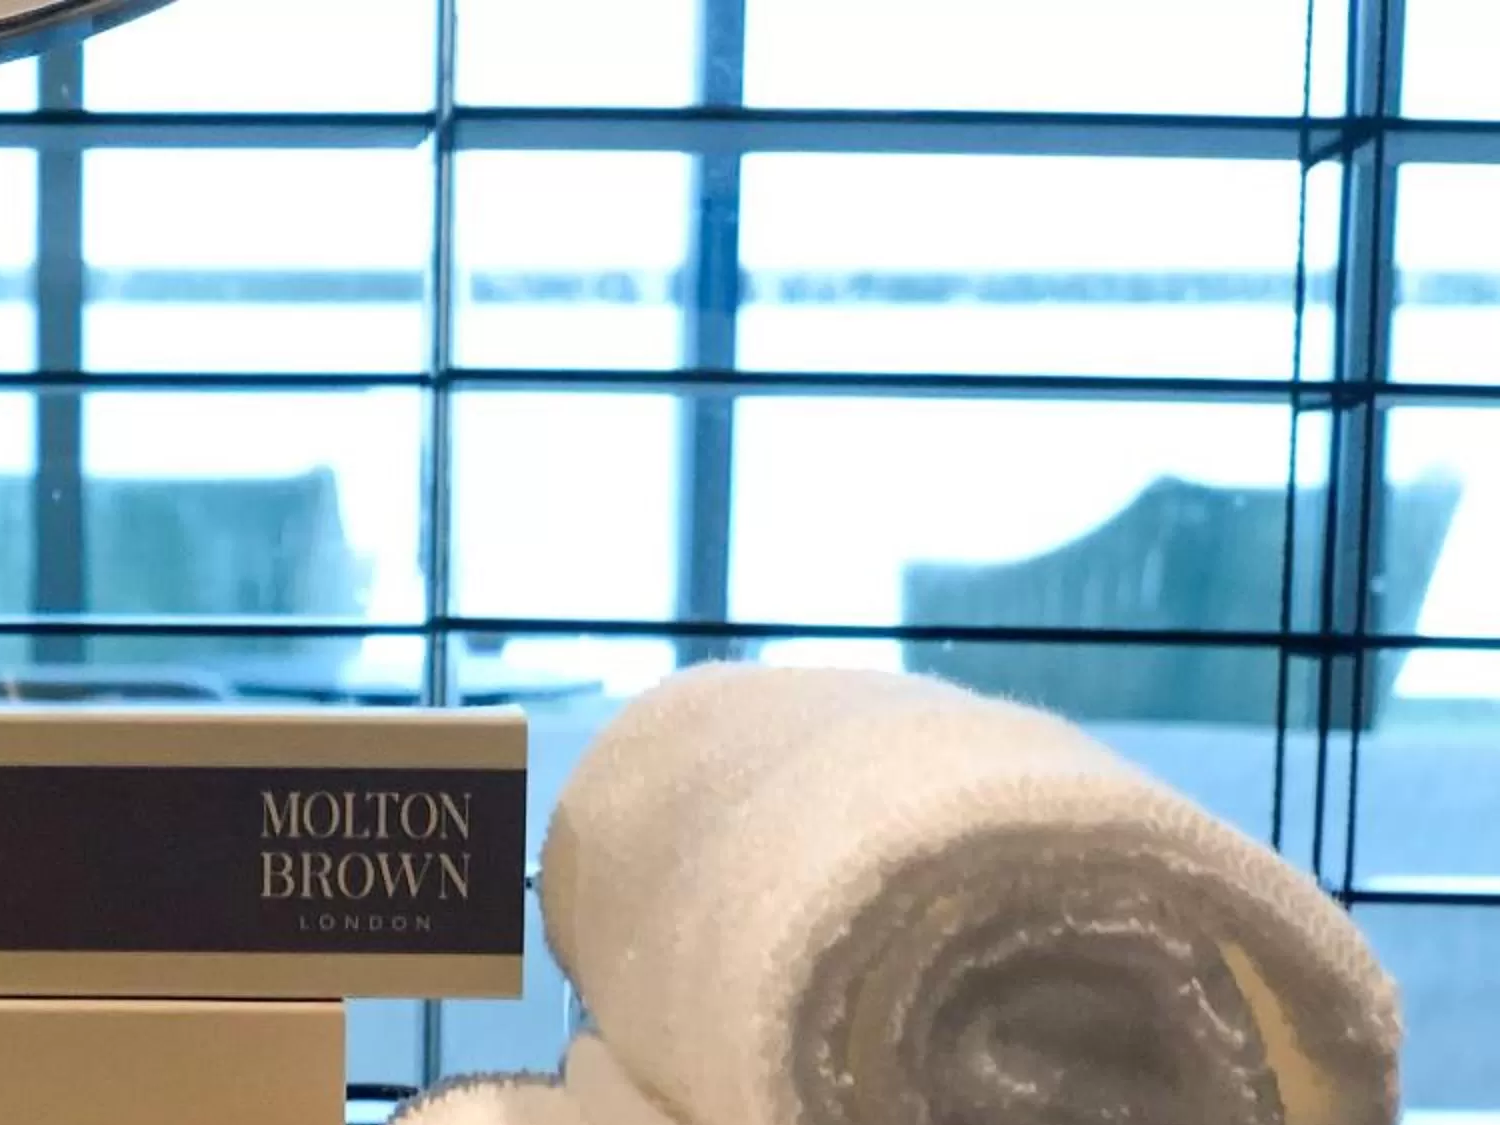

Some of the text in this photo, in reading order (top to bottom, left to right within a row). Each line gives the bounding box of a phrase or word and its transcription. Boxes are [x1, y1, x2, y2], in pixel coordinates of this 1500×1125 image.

[259, 790, 472, 841] MOLTON
[259, 851, 471, 900] BROWN
[299, 914, 433, 931] LONDON
